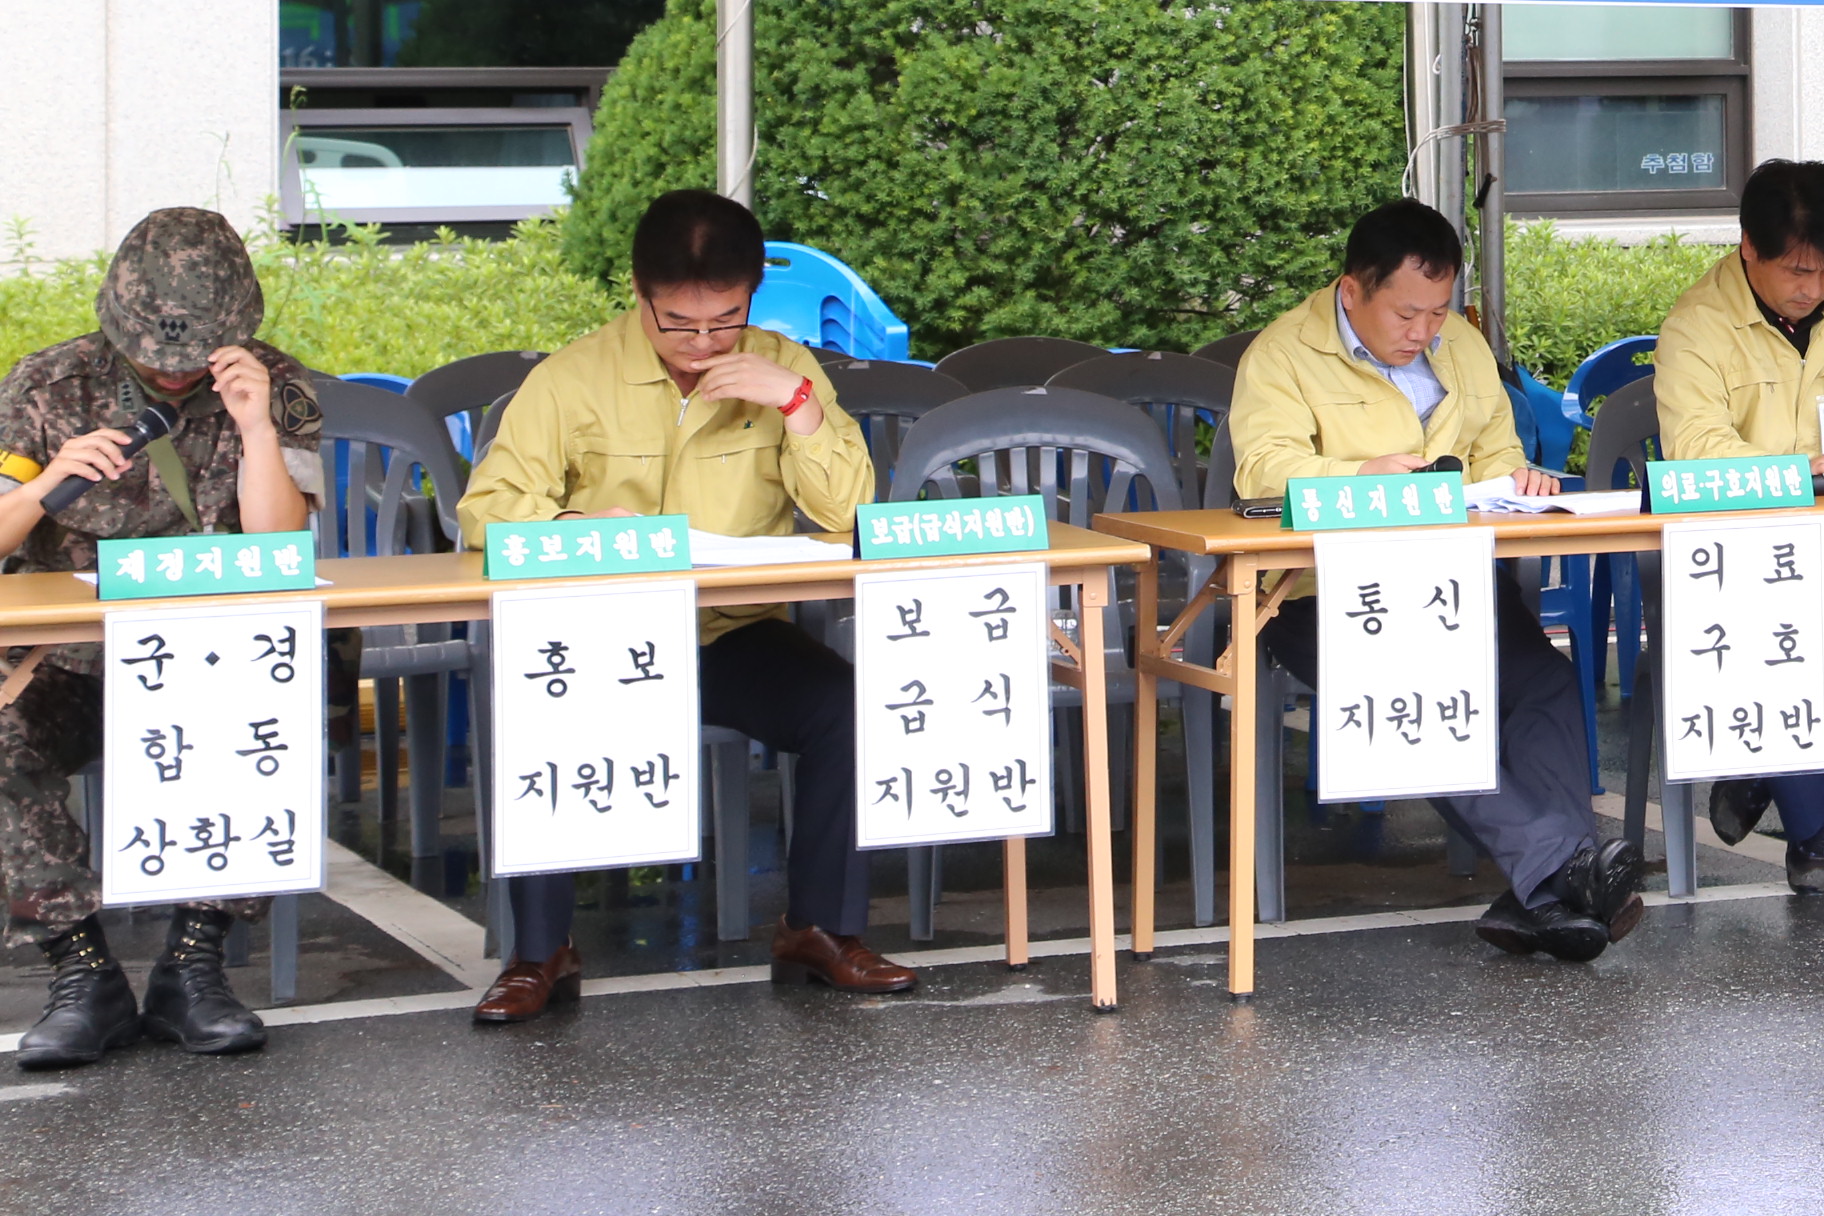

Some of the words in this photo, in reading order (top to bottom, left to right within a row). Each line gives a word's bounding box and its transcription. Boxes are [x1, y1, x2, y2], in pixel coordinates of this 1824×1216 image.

[867, 505, 1036, 546] 보급(급식지원반)
[1298, 482, 1455, 524] 통신지원반
[498, 527, 678, 568] 홍보지원반
[1337, 689, 1481, 747] 지원반
[1678, 698, 1822, 755] 지원반
[516, 753, 681, 815] 지원반
[873, 758, 1038, 819] 지원반
[120, 808, 297, 878] 상황실
